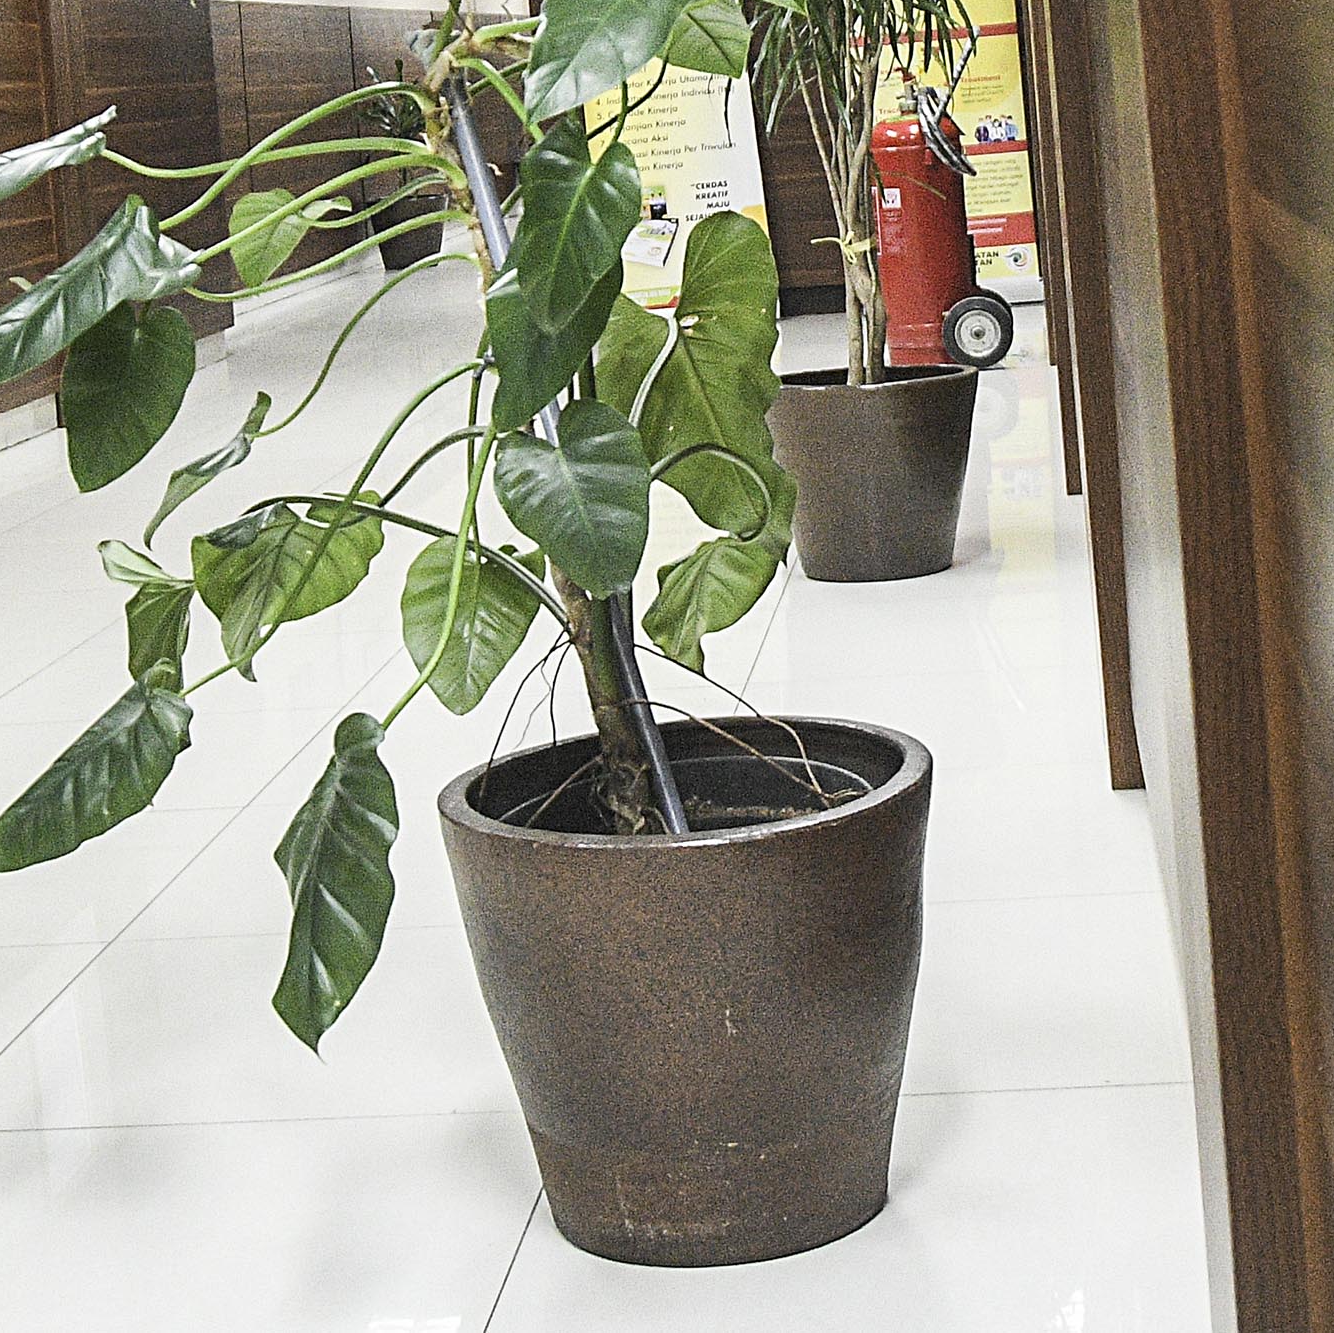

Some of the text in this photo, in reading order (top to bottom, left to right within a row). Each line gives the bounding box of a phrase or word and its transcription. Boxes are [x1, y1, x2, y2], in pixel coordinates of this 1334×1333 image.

[680, 74, 708, 84] Utama
[649, 90, 679, 102] inerja
[648, 105, 678, 117] Kinerja
[656, 118, 687, 130] Kinerja
[651, 146, 682, 157] Kinerja
[684, 145, 697, 153] Per
[653, 160, 684, 172] Kinerja
[695, 190, 729, 200] KREATIF
[706, 201, 730, 209] MAJU
